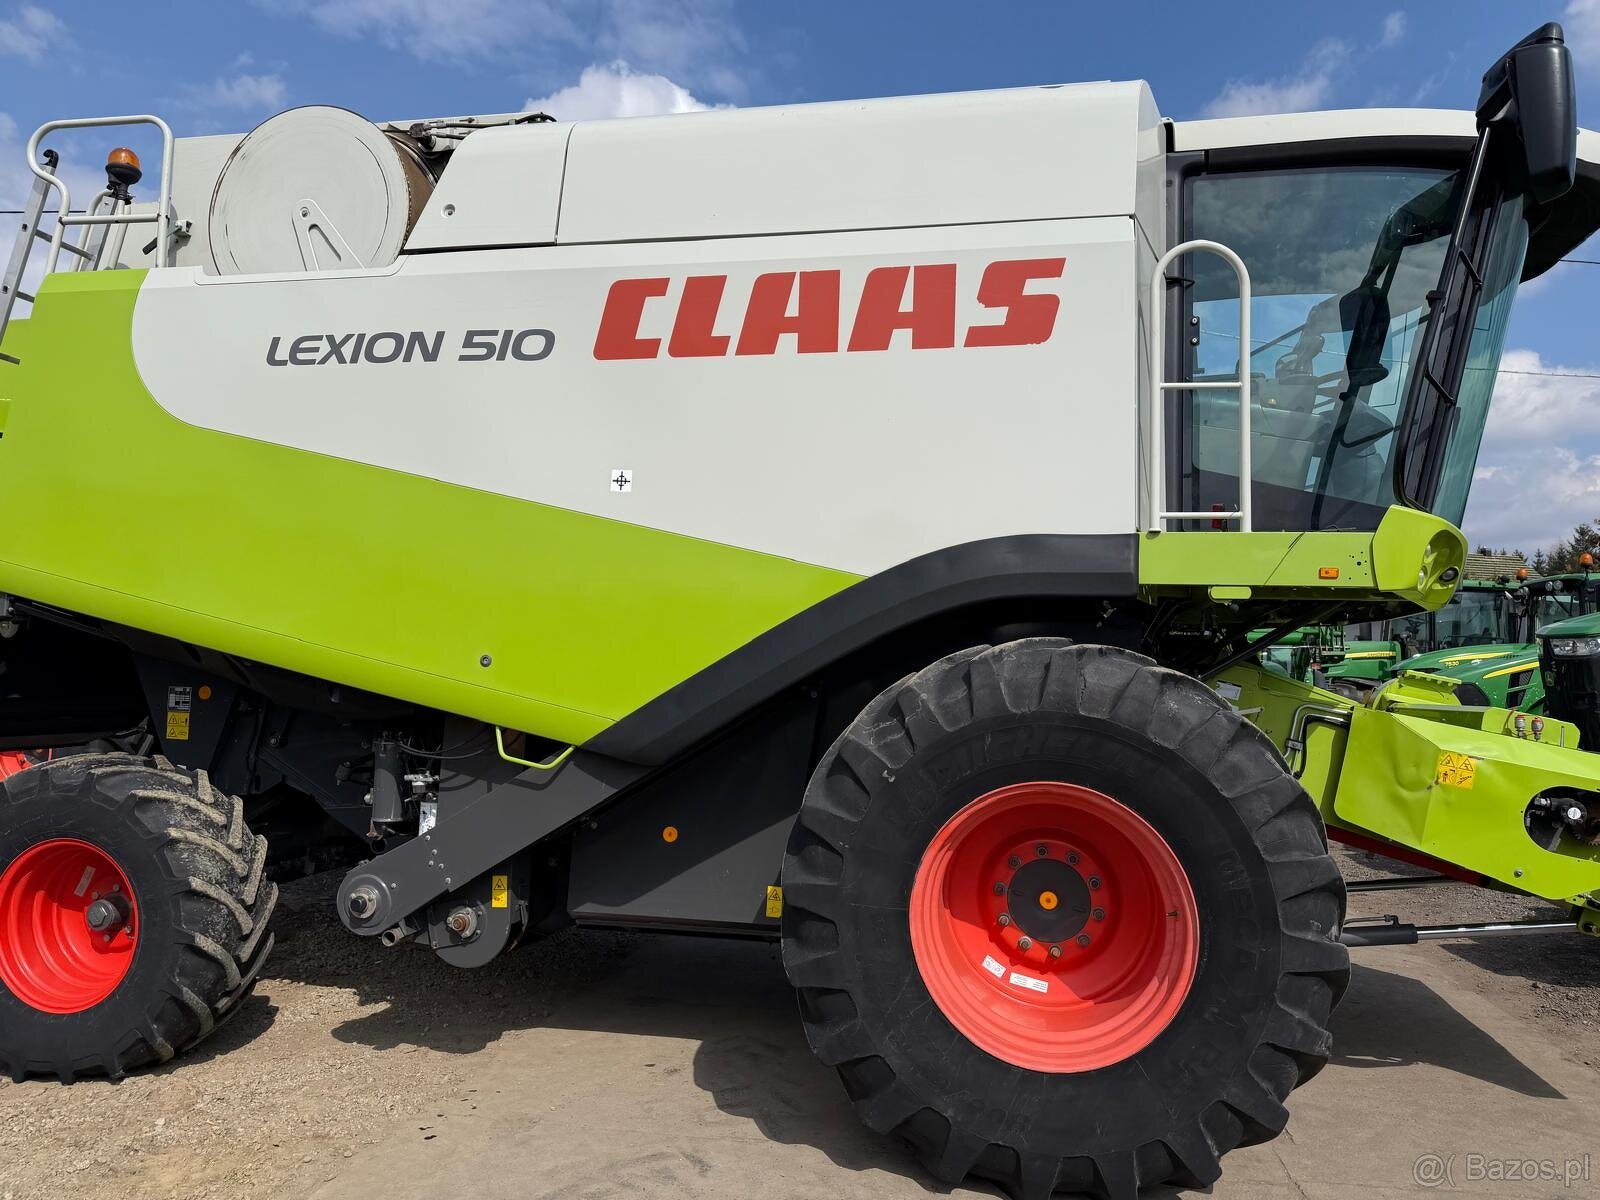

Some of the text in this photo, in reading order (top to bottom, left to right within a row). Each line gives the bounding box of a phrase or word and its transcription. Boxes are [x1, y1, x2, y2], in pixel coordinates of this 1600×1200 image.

[593, 258, 1064, 359] CLAAS
[266, 328, 555, 366] LEXION 510
